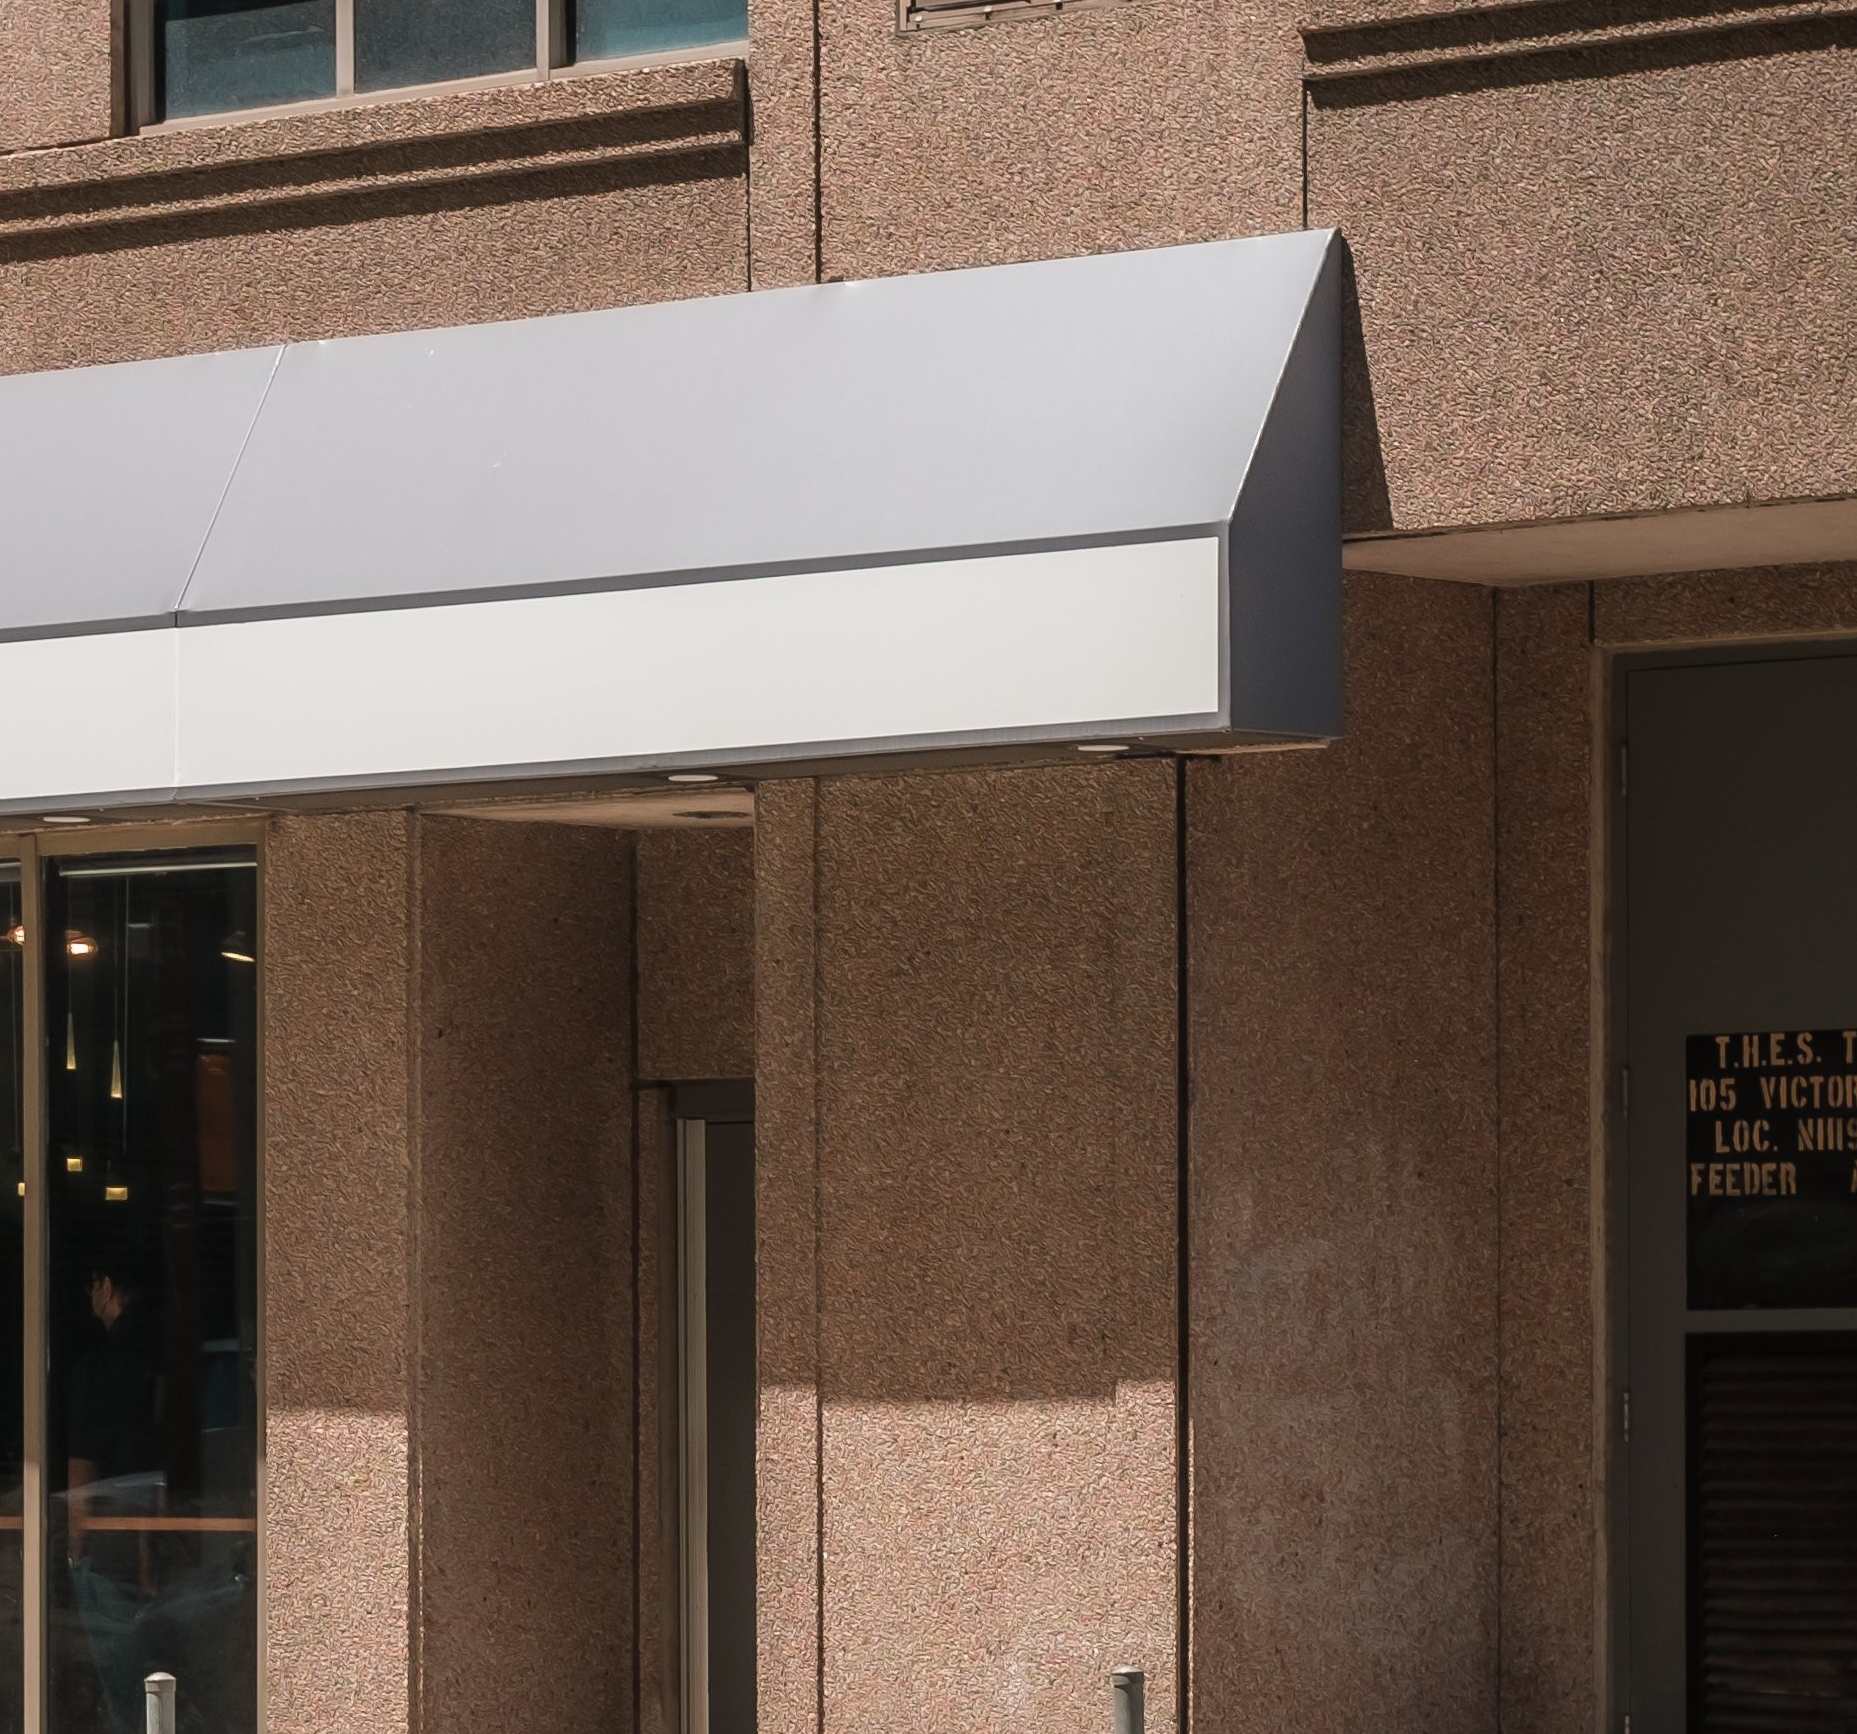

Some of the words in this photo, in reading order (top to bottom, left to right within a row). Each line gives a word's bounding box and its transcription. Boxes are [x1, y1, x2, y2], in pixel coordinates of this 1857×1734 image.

[1715, 1032, 1822, 1069] T.H.E.S.
[1715, 1119, 1779, 1154] LOC.
[1691, 1161, 1797, 1196] FEEDER
